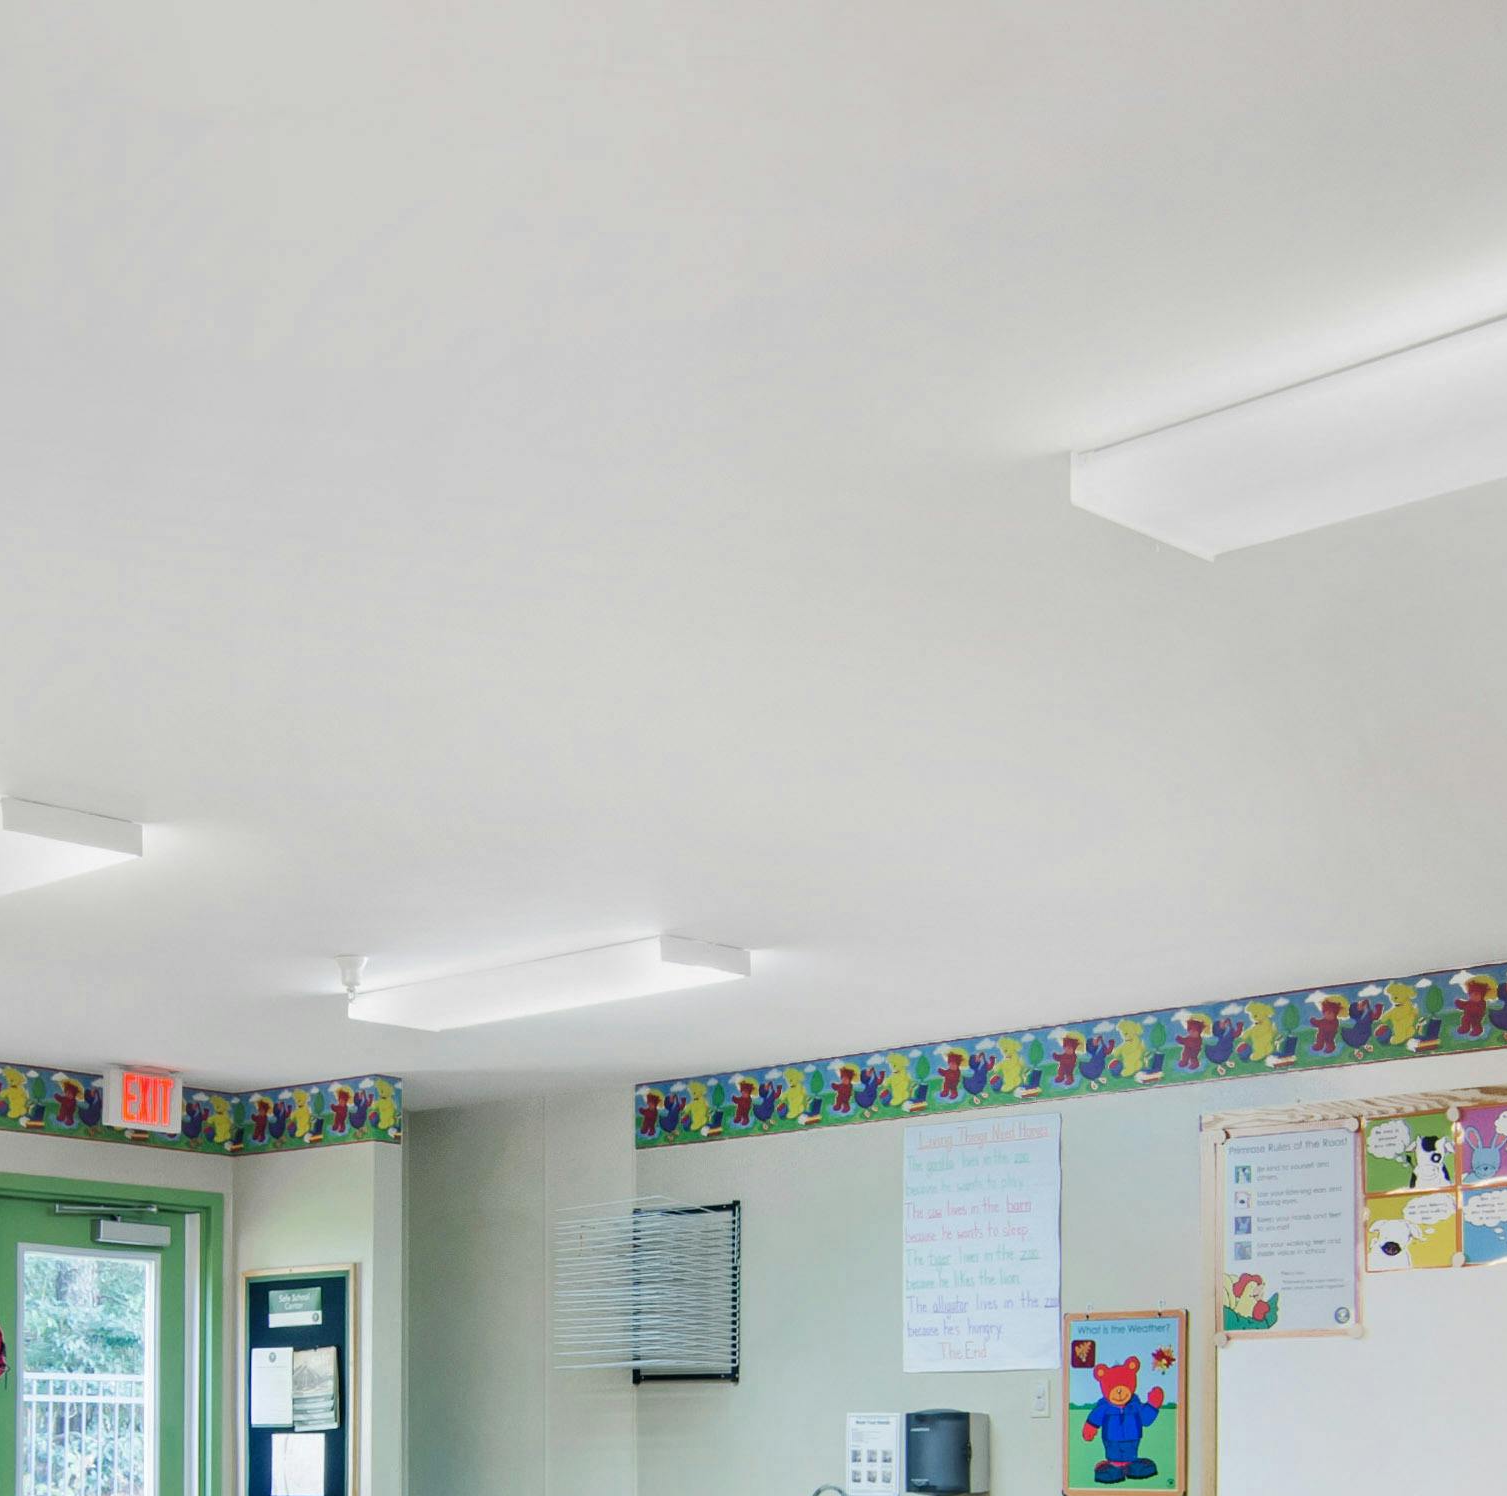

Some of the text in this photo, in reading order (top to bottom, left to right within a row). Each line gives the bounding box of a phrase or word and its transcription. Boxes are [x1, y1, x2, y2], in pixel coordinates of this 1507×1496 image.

[122, 1072, 174, 1126] EXIT
[1305, 1140, 1320, 1150] the
[293, 1292, 311, 1303] School
[1077, 1323, 1170, 1335] What is the Weather?
